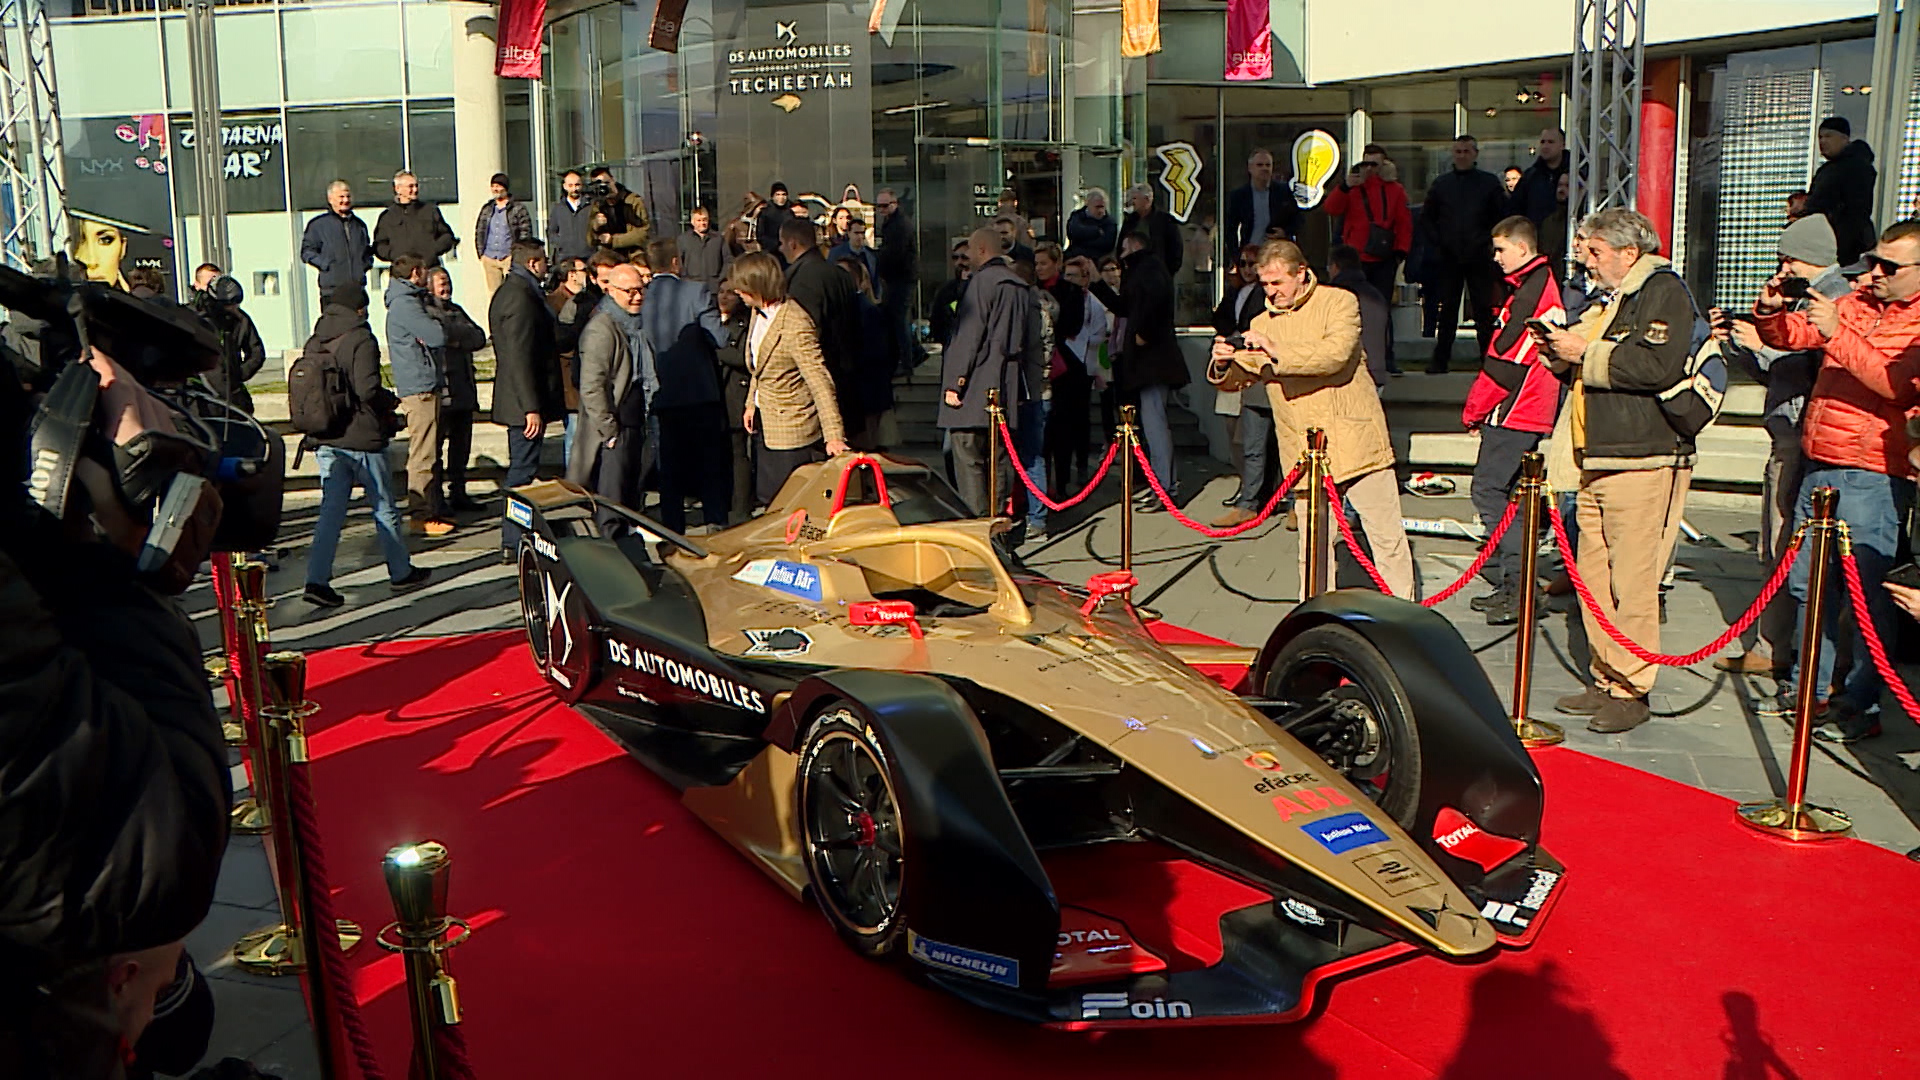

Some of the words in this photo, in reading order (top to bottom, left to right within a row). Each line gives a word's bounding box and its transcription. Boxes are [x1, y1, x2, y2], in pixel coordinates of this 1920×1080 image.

[500, 46, 535, 61] alta
[729, 50, 744, 63] DS
[747, 44, 852, 61] AUTOMOBILES
[1232, 50, 1267, 64] alta
[729, 72, 852, 95] TECHEETAH
[80, 157, 124, 176] NYX
[533, 531, 559, 562] TOTAL
[878, 610, 911, 621] TOTAL
[608, 637, 631, 667] DS
[634, 647, 766, 715] AUTOMOBILES
[1253, 771, 1320, 795] efacec
[1271, 786, 1353, 823] ABB
[1434, 823, 1481, 849] TOTAL
[931, 949, 1009, 977] MICHELIN
[1082, 991, 1193, 1020] Foin
